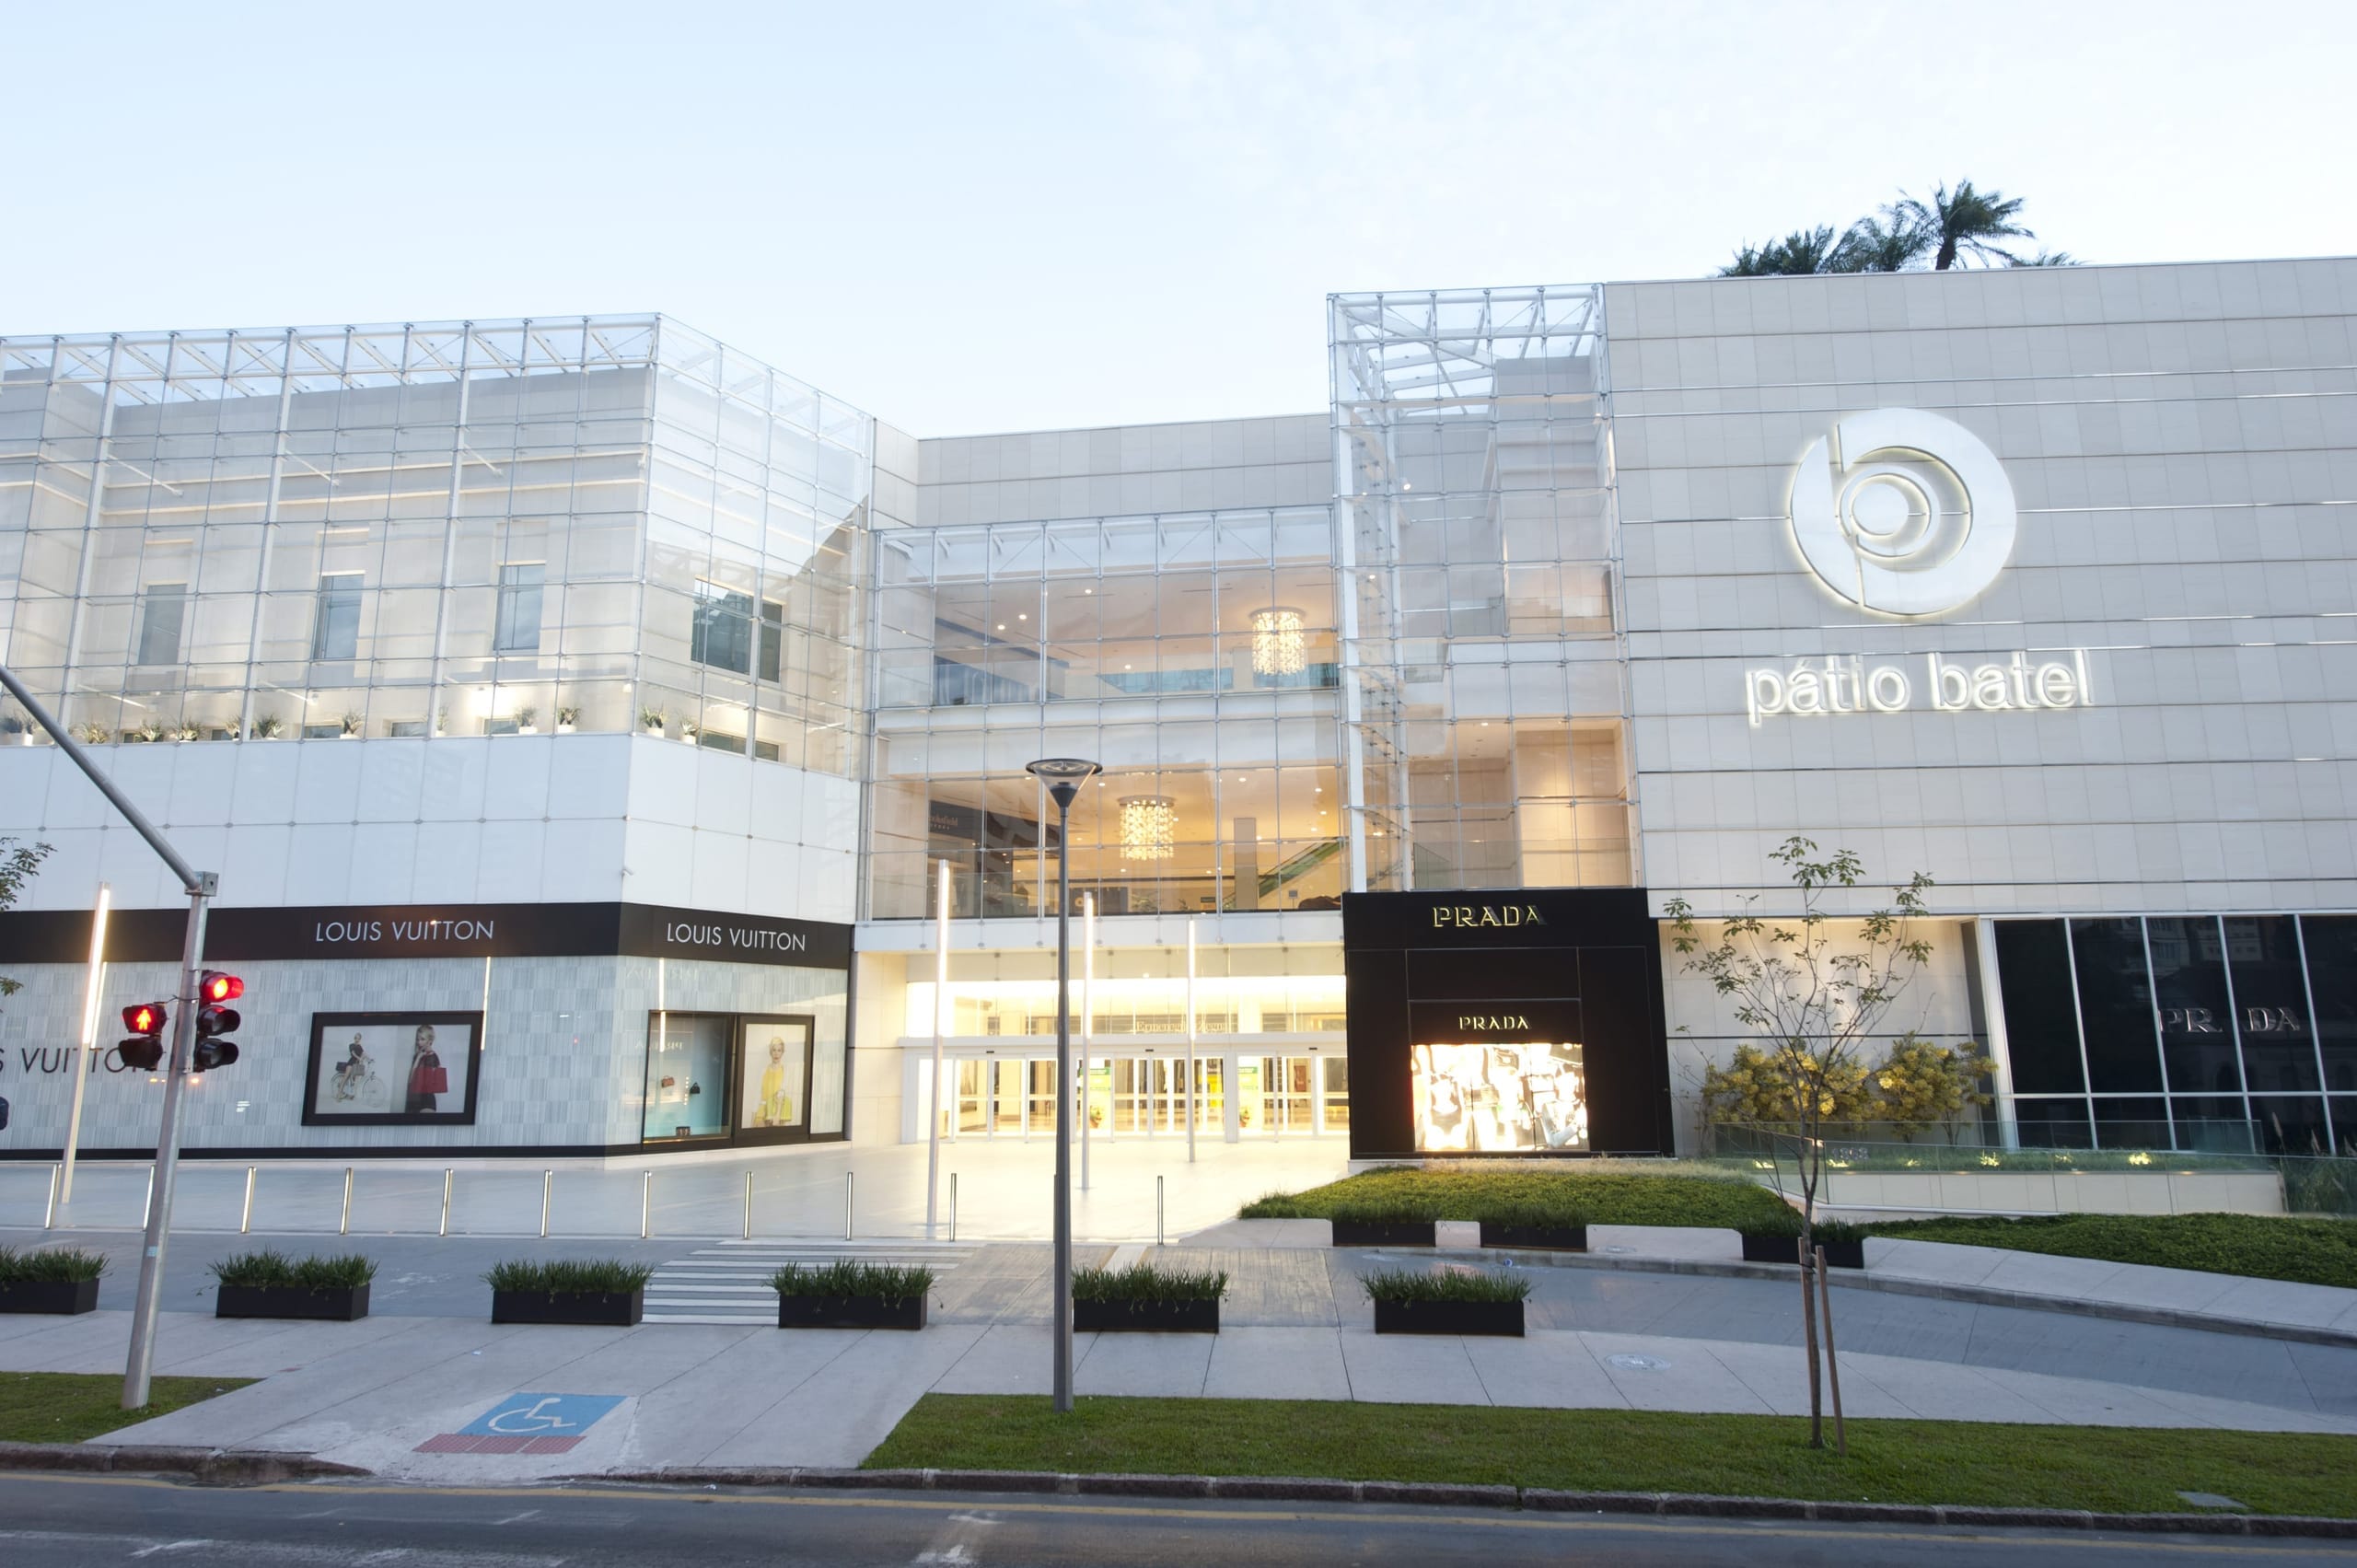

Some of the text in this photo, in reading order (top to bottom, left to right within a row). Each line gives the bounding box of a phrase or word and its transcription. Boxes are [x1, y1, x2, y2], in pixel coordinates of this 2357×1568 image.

[1747, 649, 2095, 726] pátio batel
[1432, 905, 1547, 928] PRADA
[316, 920, 494, 942] LOUIS VUITTON
[667, 923, 807, 952] LOUIS VUITTON
[1458, 1016, 1532, 1031] PRADA
[2157, 1007, 2300, 1033] PRDA
[21, 1048, 138, 1074] VUITO
